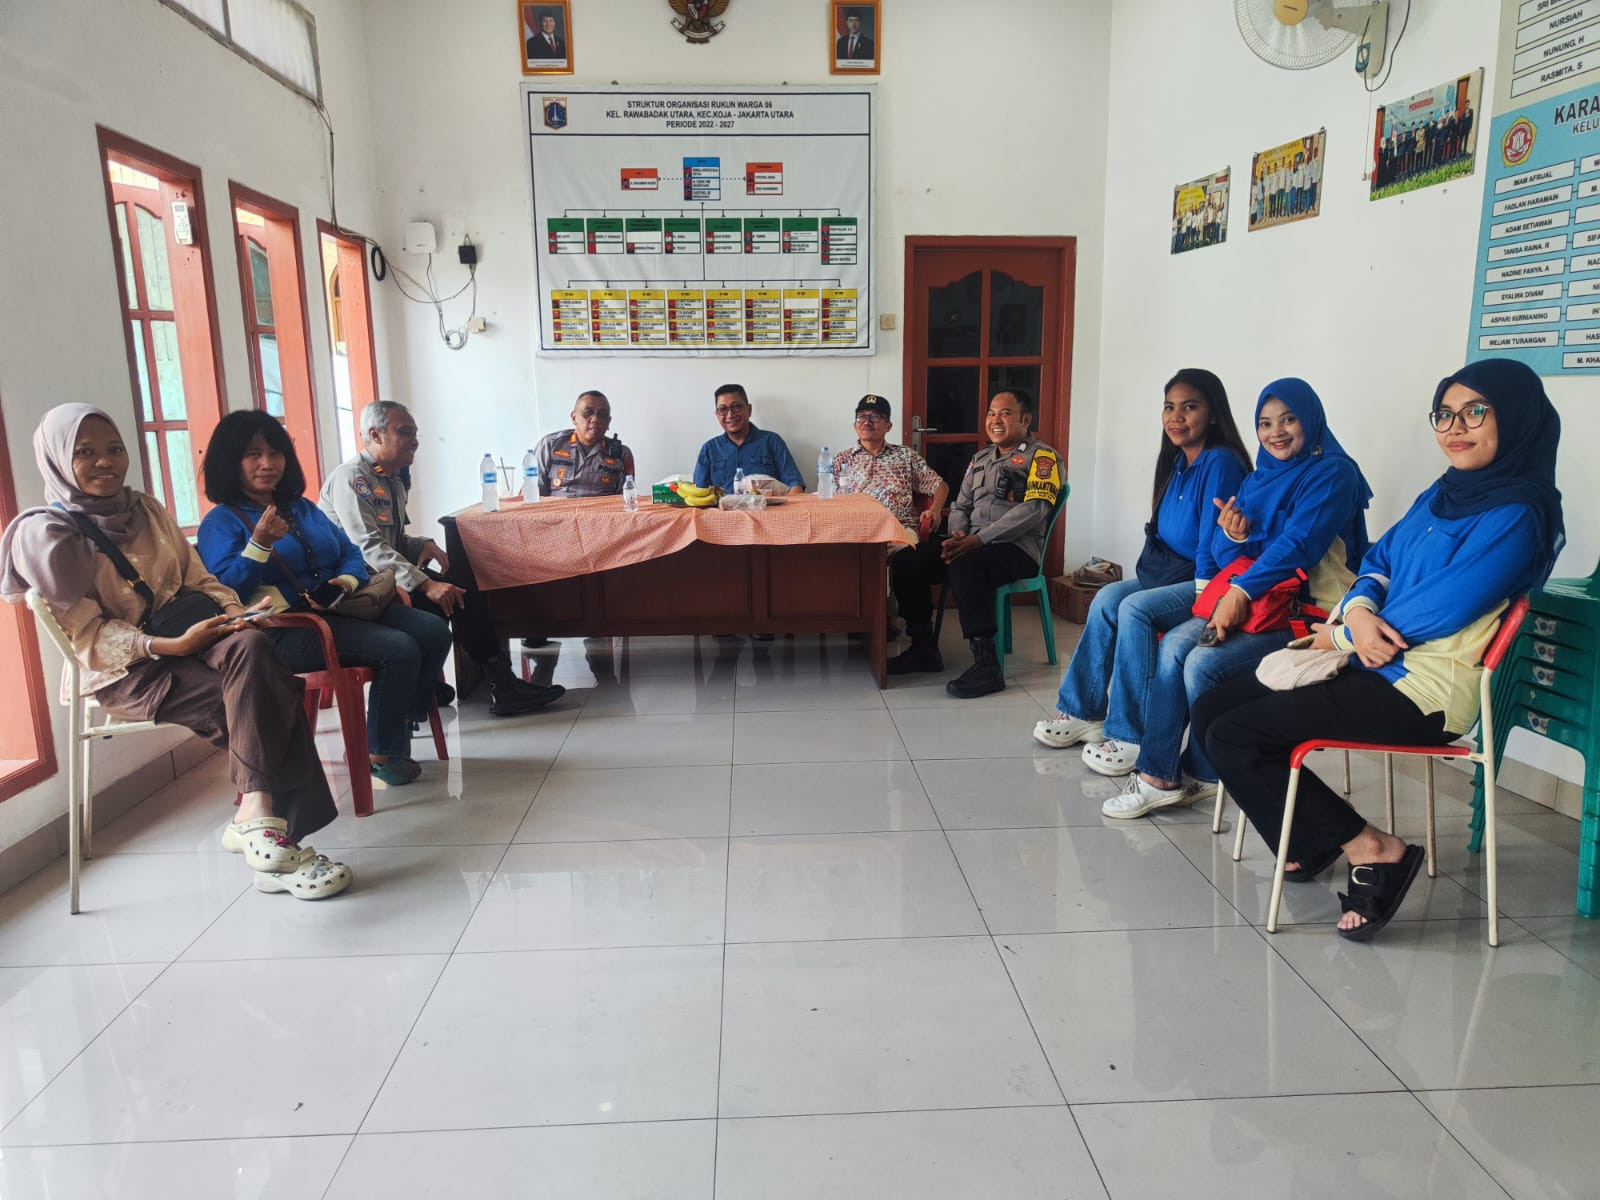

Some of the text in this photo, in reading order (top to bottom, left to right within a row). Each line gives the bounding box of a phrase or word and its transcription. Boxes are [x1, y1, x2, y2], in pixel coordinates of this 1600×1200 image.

[1549, 9, 1583, 30] NURSIAH
[1578, 35, 1585, 44] H
[1577, 61, 1583, 70] S
[1554, 95, 1600, 125] KARA
[1504, 194, 1559, 211] FADLAN HARAMAIN
[1505, 218, 1553, 234] ADAM SETIAWAN
[1501, 269, 1521, 277] NADINE
[1512, 312, 1548, 321] KURNIANING
[1512, 336, 1547, 345] TURANGAN
